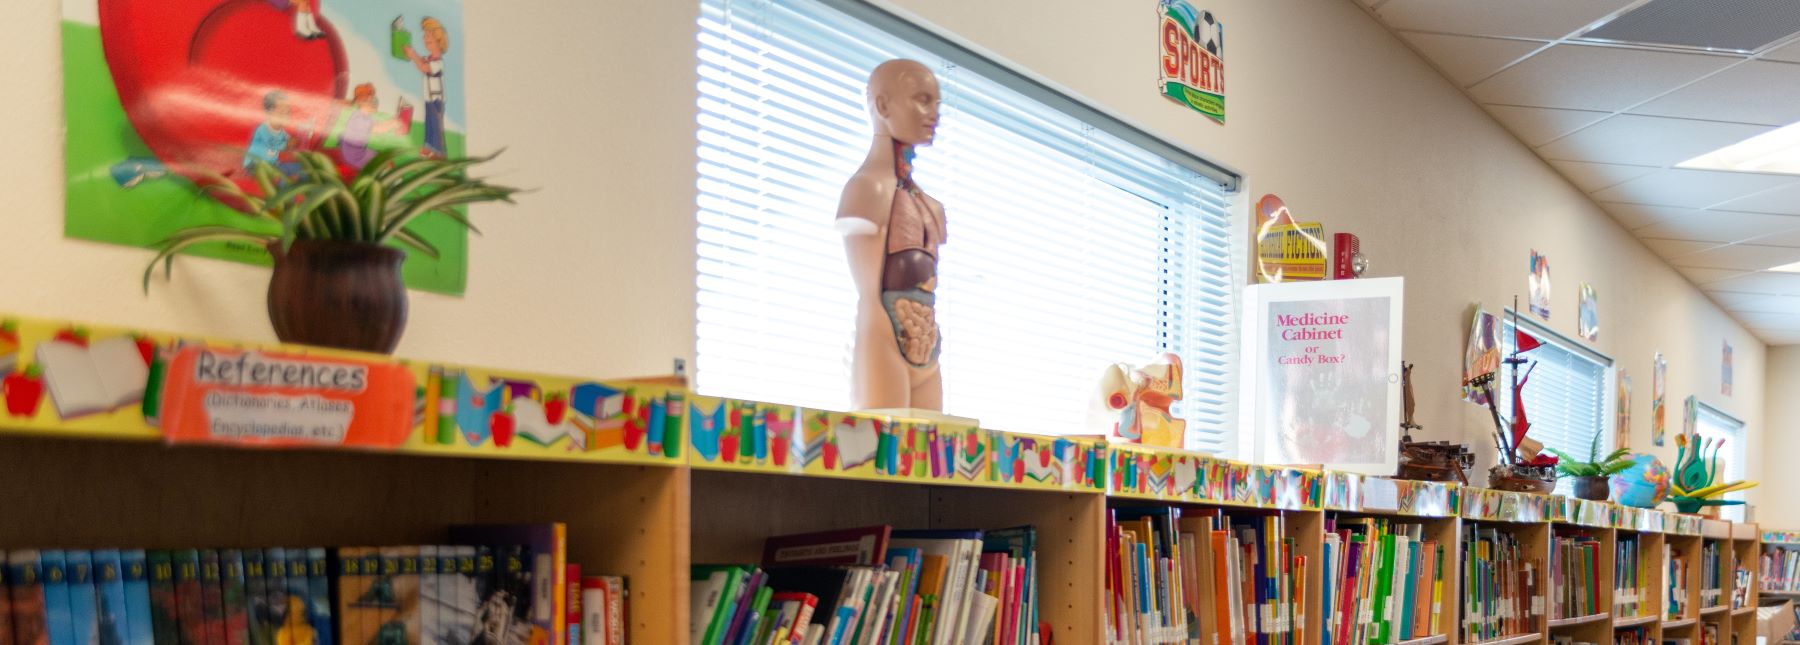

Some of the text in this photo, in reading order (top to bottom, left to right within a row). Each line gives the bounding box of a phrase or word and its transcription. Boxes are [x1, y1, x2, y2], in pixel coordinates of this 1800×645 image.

[1163, 18, 1225, 95] SPORTS
[1287, 228, 1322, 259] FICTION
[1277, 313, 1349, 327] Medicine
[1282, 328, 1343, 341] Cabinet
[1278, 354, 1345, 366] Candy Box?
[198, 351, 366, 389] References
[131, 562, 142, 579] 9
[183, 563, 195, 577] 11
[205, 563, 218, 578] 12
[248, 561, 262, 576] 14
[272, 561, 285, 576] 15
[292, 561, 306, 576] 16
[312, 560, 326, 575] 17
[345, 558, 358, 573] 18
[365, 558, 378, 572] 19
[404, 558, 417, 572] 21
[423, 557, 436, 573] 22
[461, 557, 474, 571] 24
[479, 555, 493, 571] 25
[508, 557, 521, 571] 26
[77, 564, 87, 583] 7
[156, 563, 171, 579] 10
